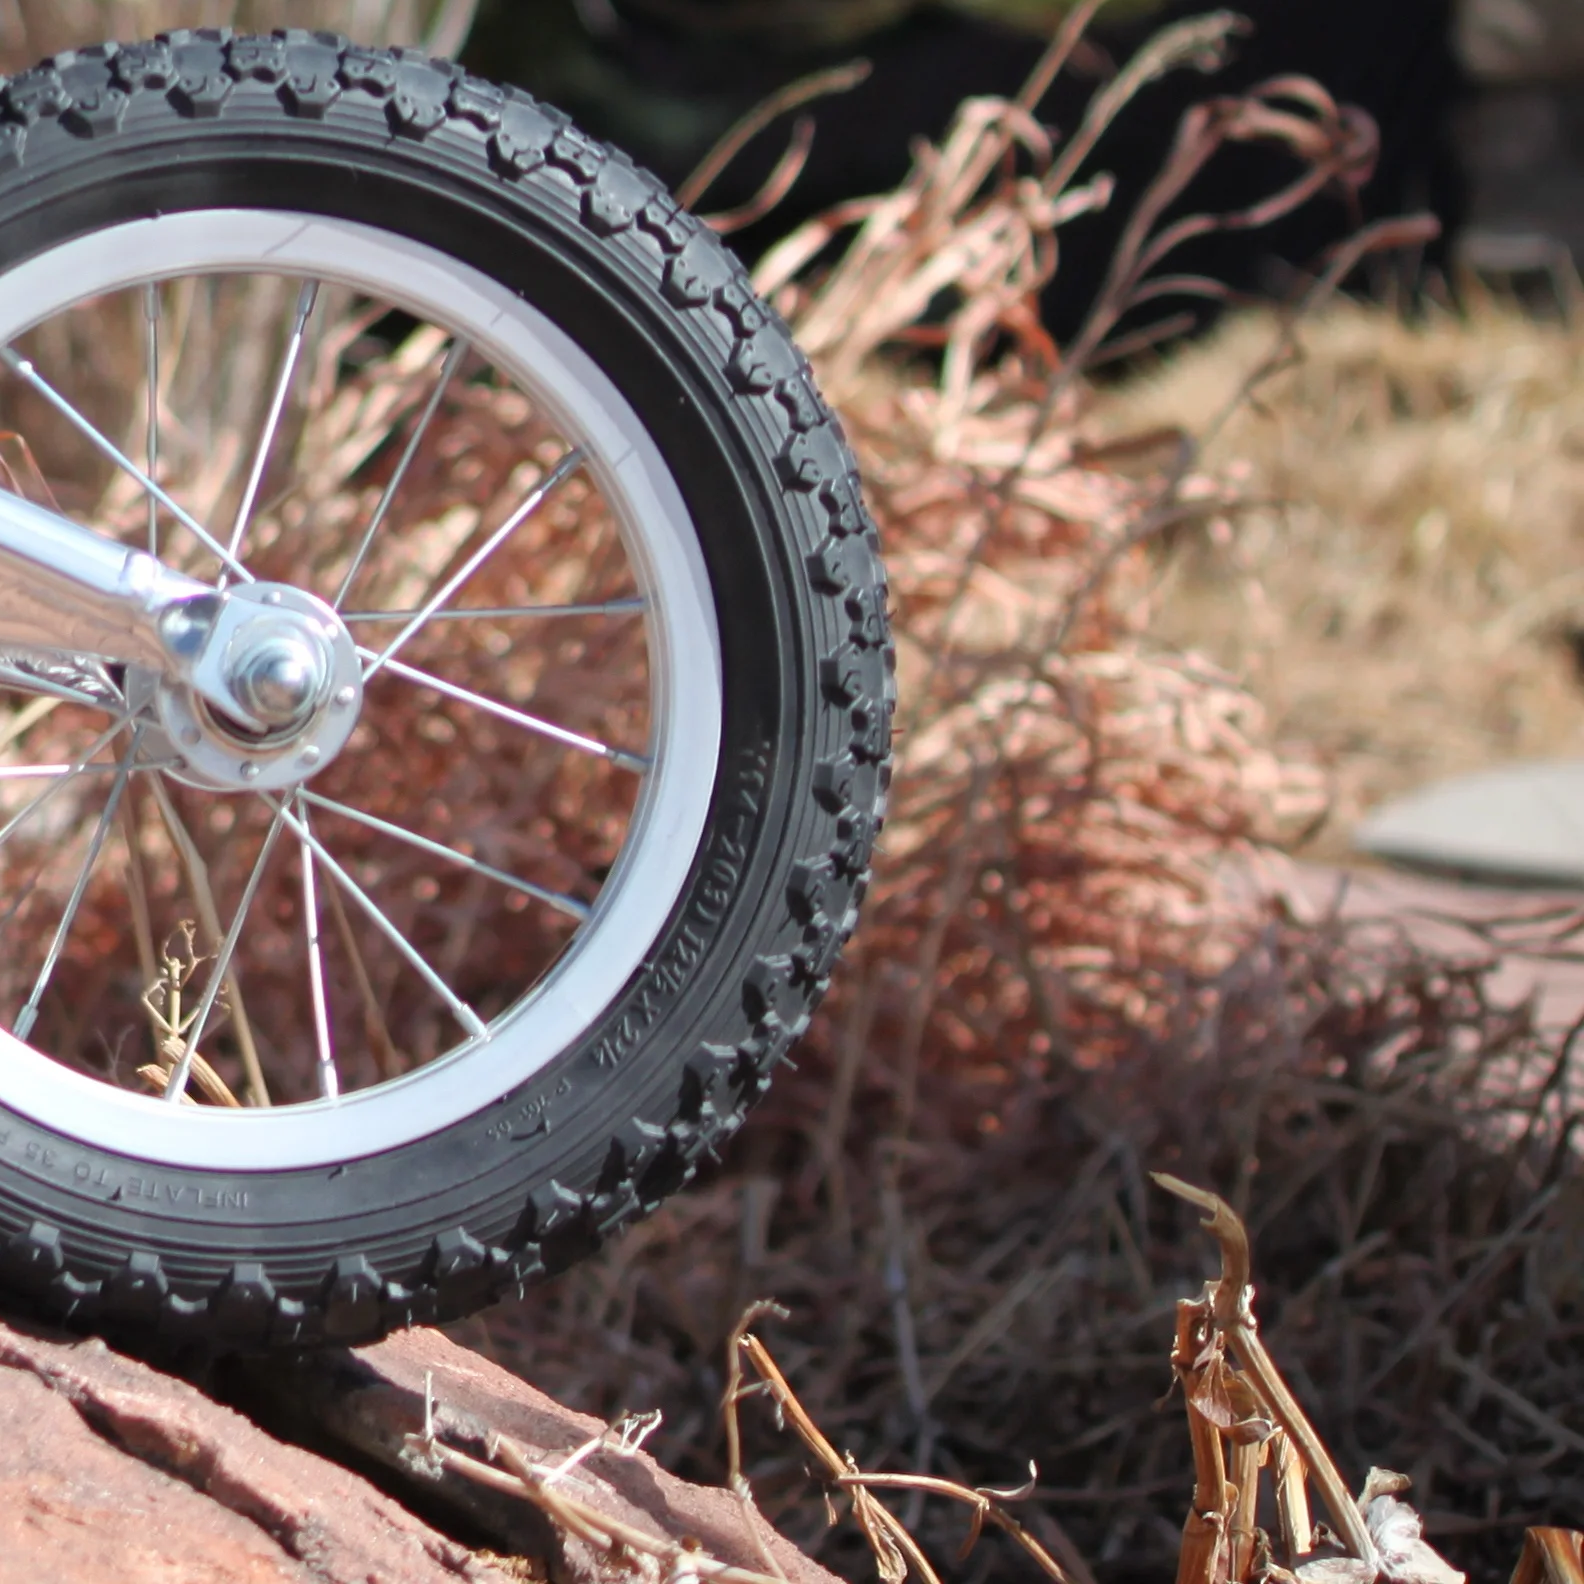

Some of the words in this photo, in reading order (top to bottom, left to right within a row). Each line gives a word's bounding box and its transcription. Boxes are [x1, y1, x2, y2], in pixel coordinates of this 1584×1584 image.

[21, 1138, 60, 1169] 35
[70, 1159, 112, 1189] TO
[124, 1176, 249, 1210] INFLATE
